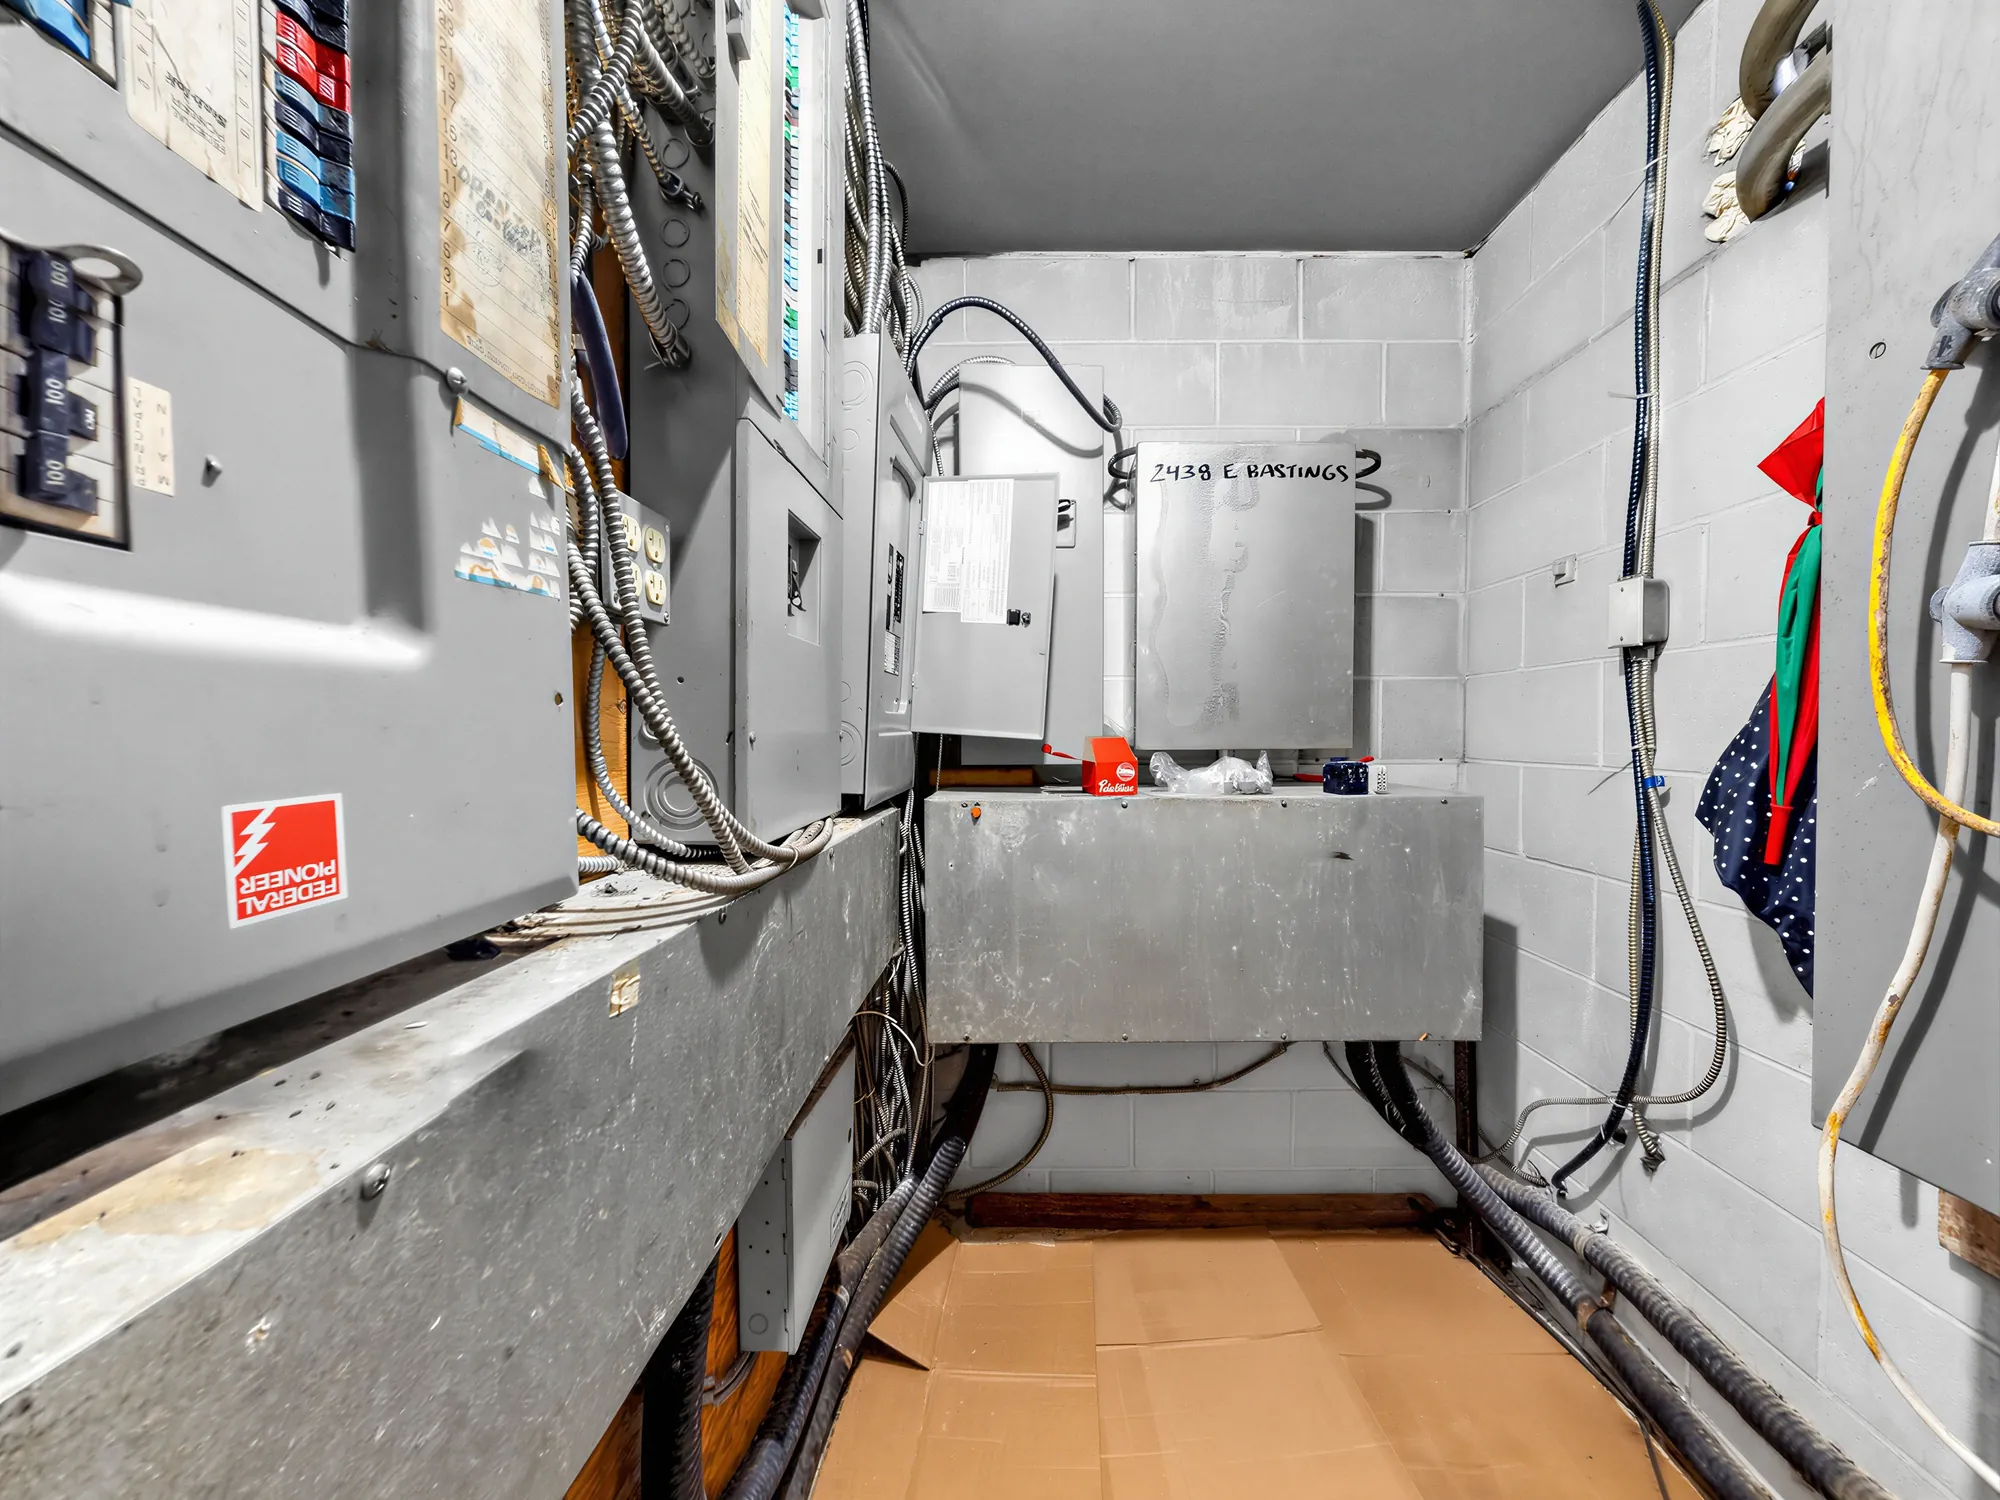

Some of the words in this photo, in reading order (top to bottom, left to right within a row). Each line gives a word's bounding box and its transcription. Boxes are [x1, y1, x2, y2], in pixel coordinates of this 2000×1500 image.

[443, 216, 451, 232] 7
[50, 260, 69, 289] 100
[45, 378, 67, 406] 100
[46, 460, 66, 486] 100
[1150, 463, 1212, 483] 2438
[1223, 462, 1238, 479] E
[238, 858, 337, 895] PIONEER
[238, 876, 338, 916] FEDERAL
